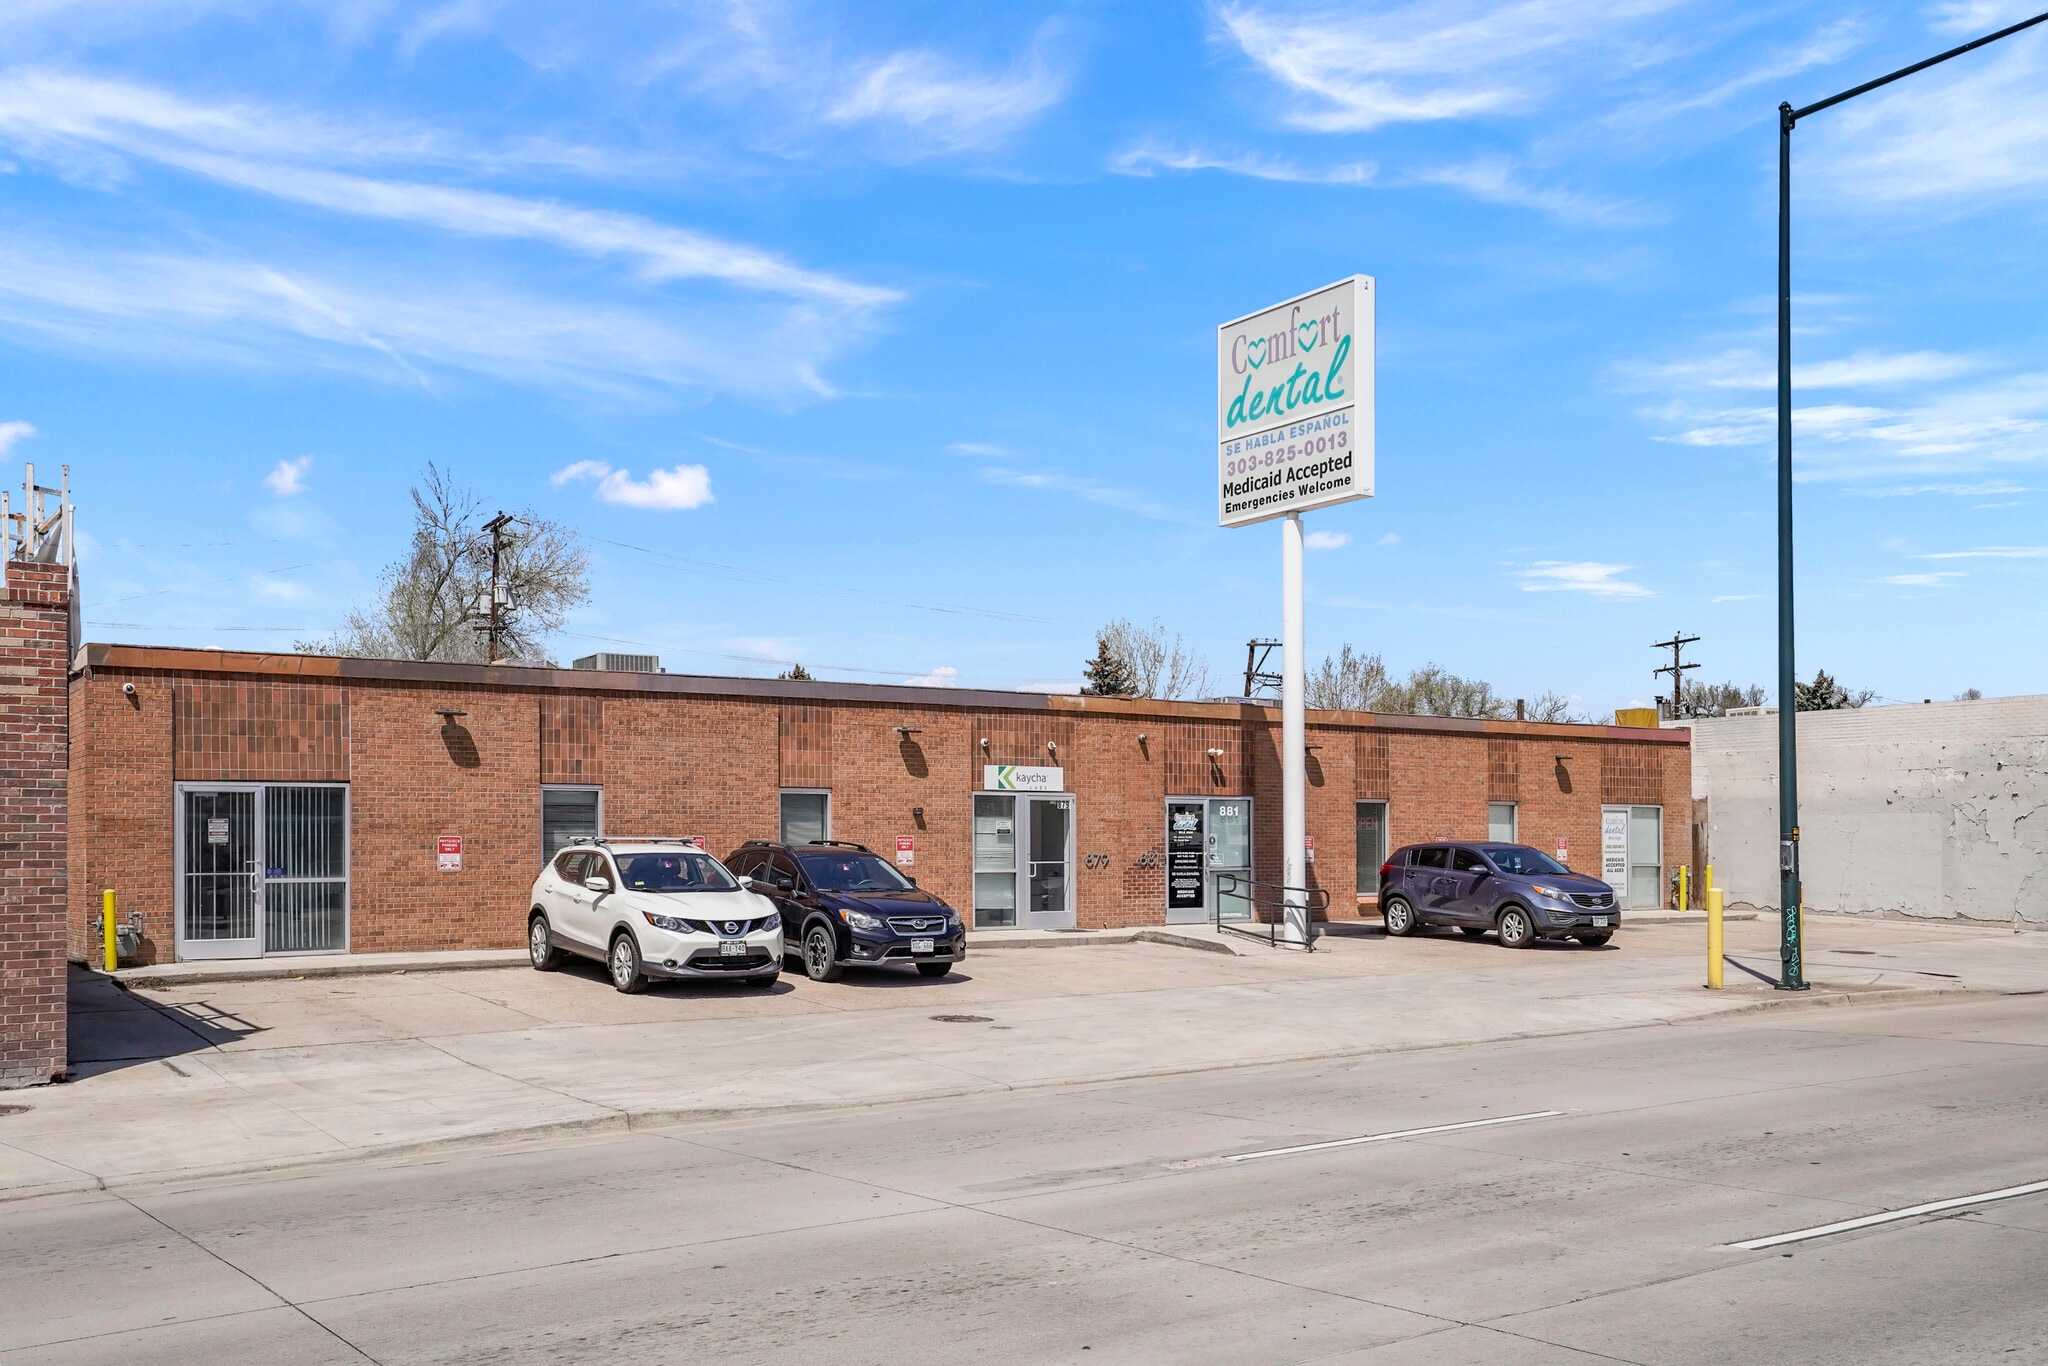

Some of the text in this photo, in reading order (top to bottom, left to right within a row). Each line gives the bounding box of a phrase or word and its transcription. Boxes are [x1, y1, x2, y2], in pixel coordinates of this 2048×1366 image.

[1226, 334, 1351, 428] dental
[1226, 412, 1349, 456] SE HABLA ESPAÑOL
[1227, 431, 1348, 477] 303-825-0013
[1223, 451, 1353, 499] Medicaid Accepted
[1225, 476, 1351, 514] Emergencies Welcome
[1016, 773, 1047, 784] kaycha
[1219, 806, 1239, 816] 881
[1605, 824, 1625, 834] dental
[1085, 853, 1110, 870] 879
